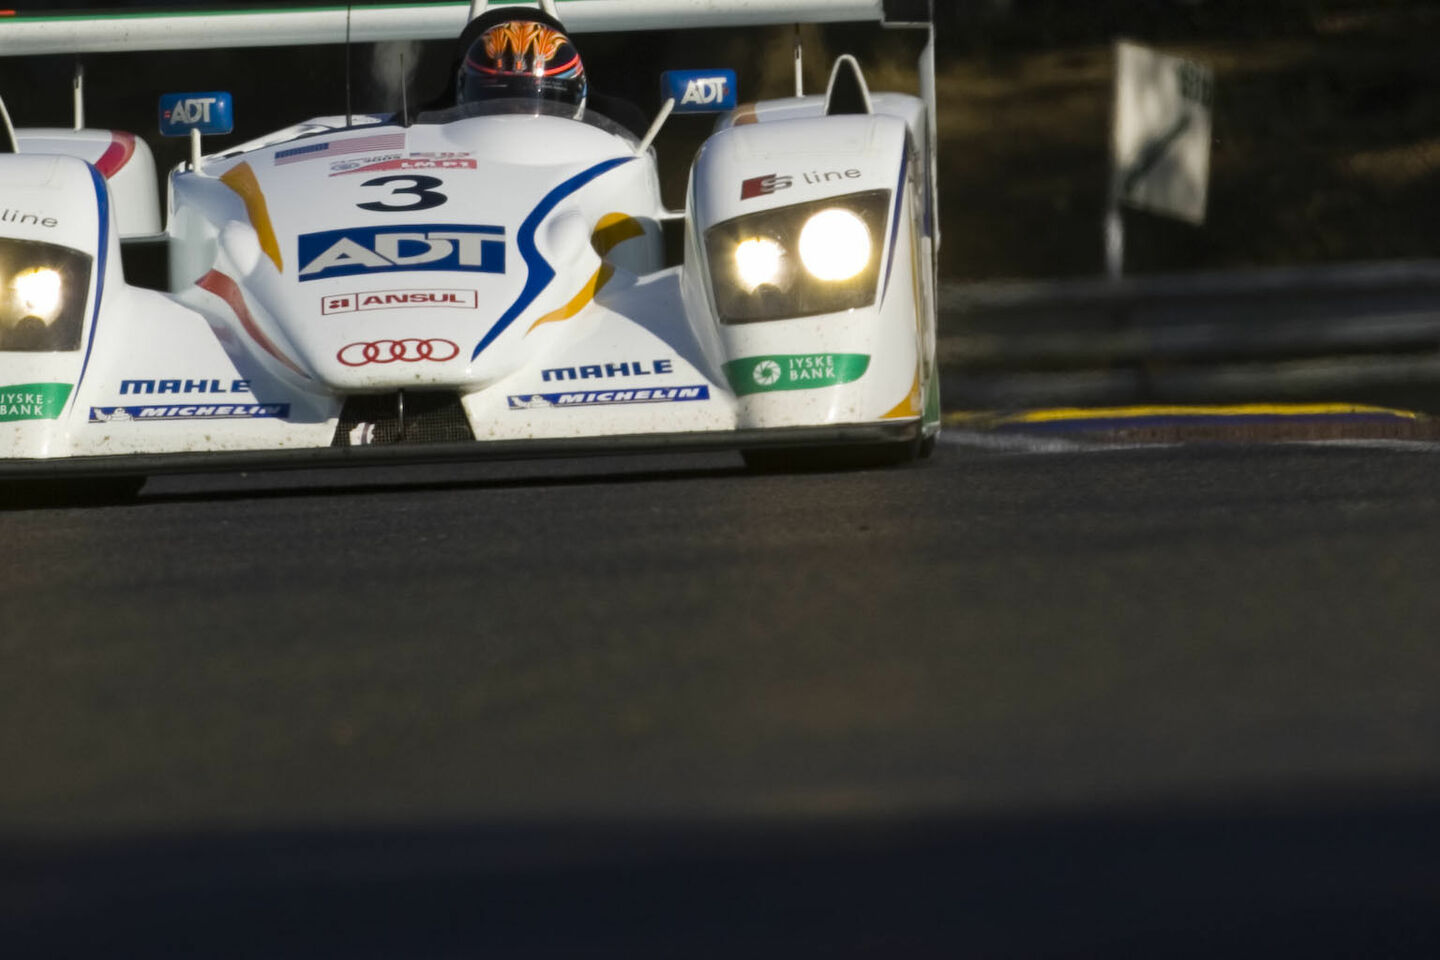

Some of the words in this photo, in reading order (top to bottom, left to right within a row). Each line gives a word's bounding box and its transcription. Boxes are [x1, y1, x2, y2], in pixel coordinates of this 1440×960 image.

[680, 77, 727, 104] ADT
[169, 98, 216, 124] ADT
[803, 168, 861, 184] line
[356, 174, 448, 212] 3
[1, 208, 58, 228] line
[299, 232, 505, 276] ADT
[362, 293, 466, 306] ANSUL
[789, 355, 834, 369] JYSKE
[541, 359, 673, 382] MAHLE
[789, 367, 835, 381] BANK
[119, 379, 252, 395] MAHLE
[0, 393, 44, 405] JYSKE
[557, 387, 701, 404] MICHELIN
[0, 404, 44, 416] BANK
